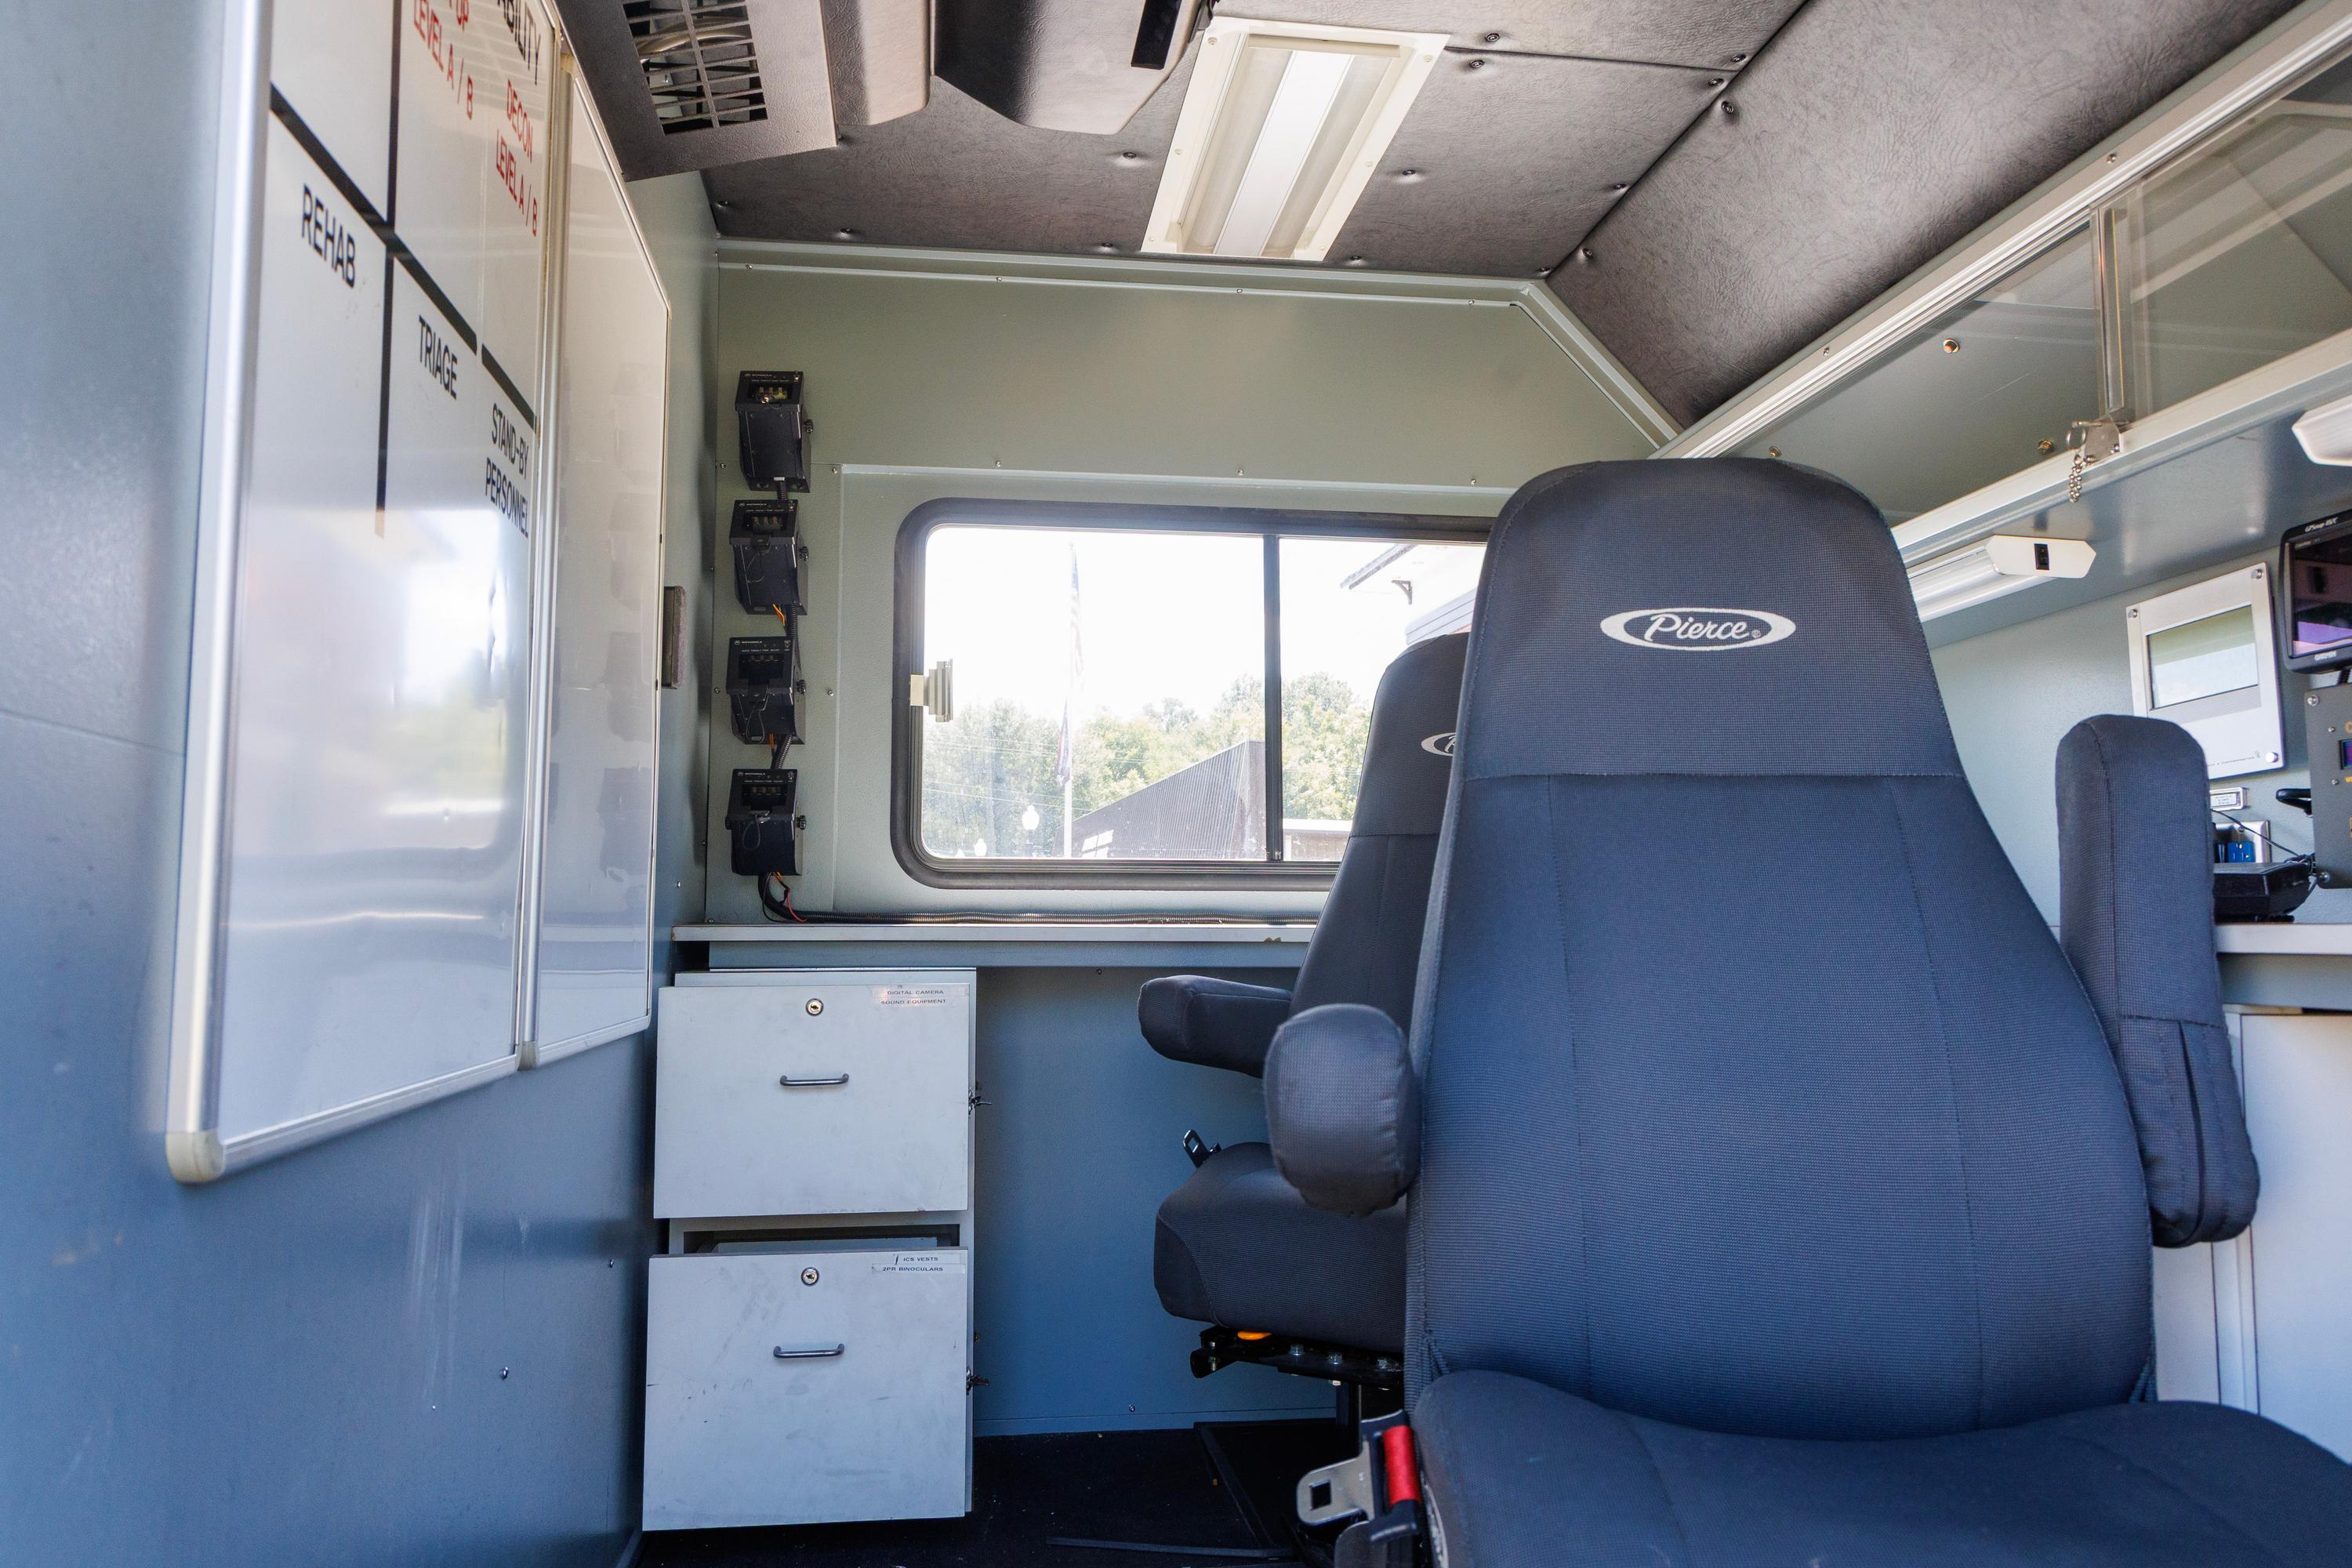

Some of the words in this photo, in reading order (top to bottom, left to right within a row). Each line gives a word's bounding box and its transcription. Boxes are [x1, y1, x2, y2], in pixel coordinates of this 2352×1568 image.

[414, 0, 444, 72] LEVEL
[447, 44, 454, 89] A
[466, 75, 474, 120] B
[497, 0, 541, 85] BILITY
[507, 78, 533, 163] DECON
[496, 129, 517, 202] LEVEL
[518, 174, 524, 215] A
[532, 197, 538, 238] B
[302, 185, 356, 289] REHAB
[419, 315, 458, 401] TRIAGE
[492, 402, 529, 479] STAND-BY
[485, 457, 529, 539] PERSONNEL
[1644, 613, 1749, 641] Pierce
